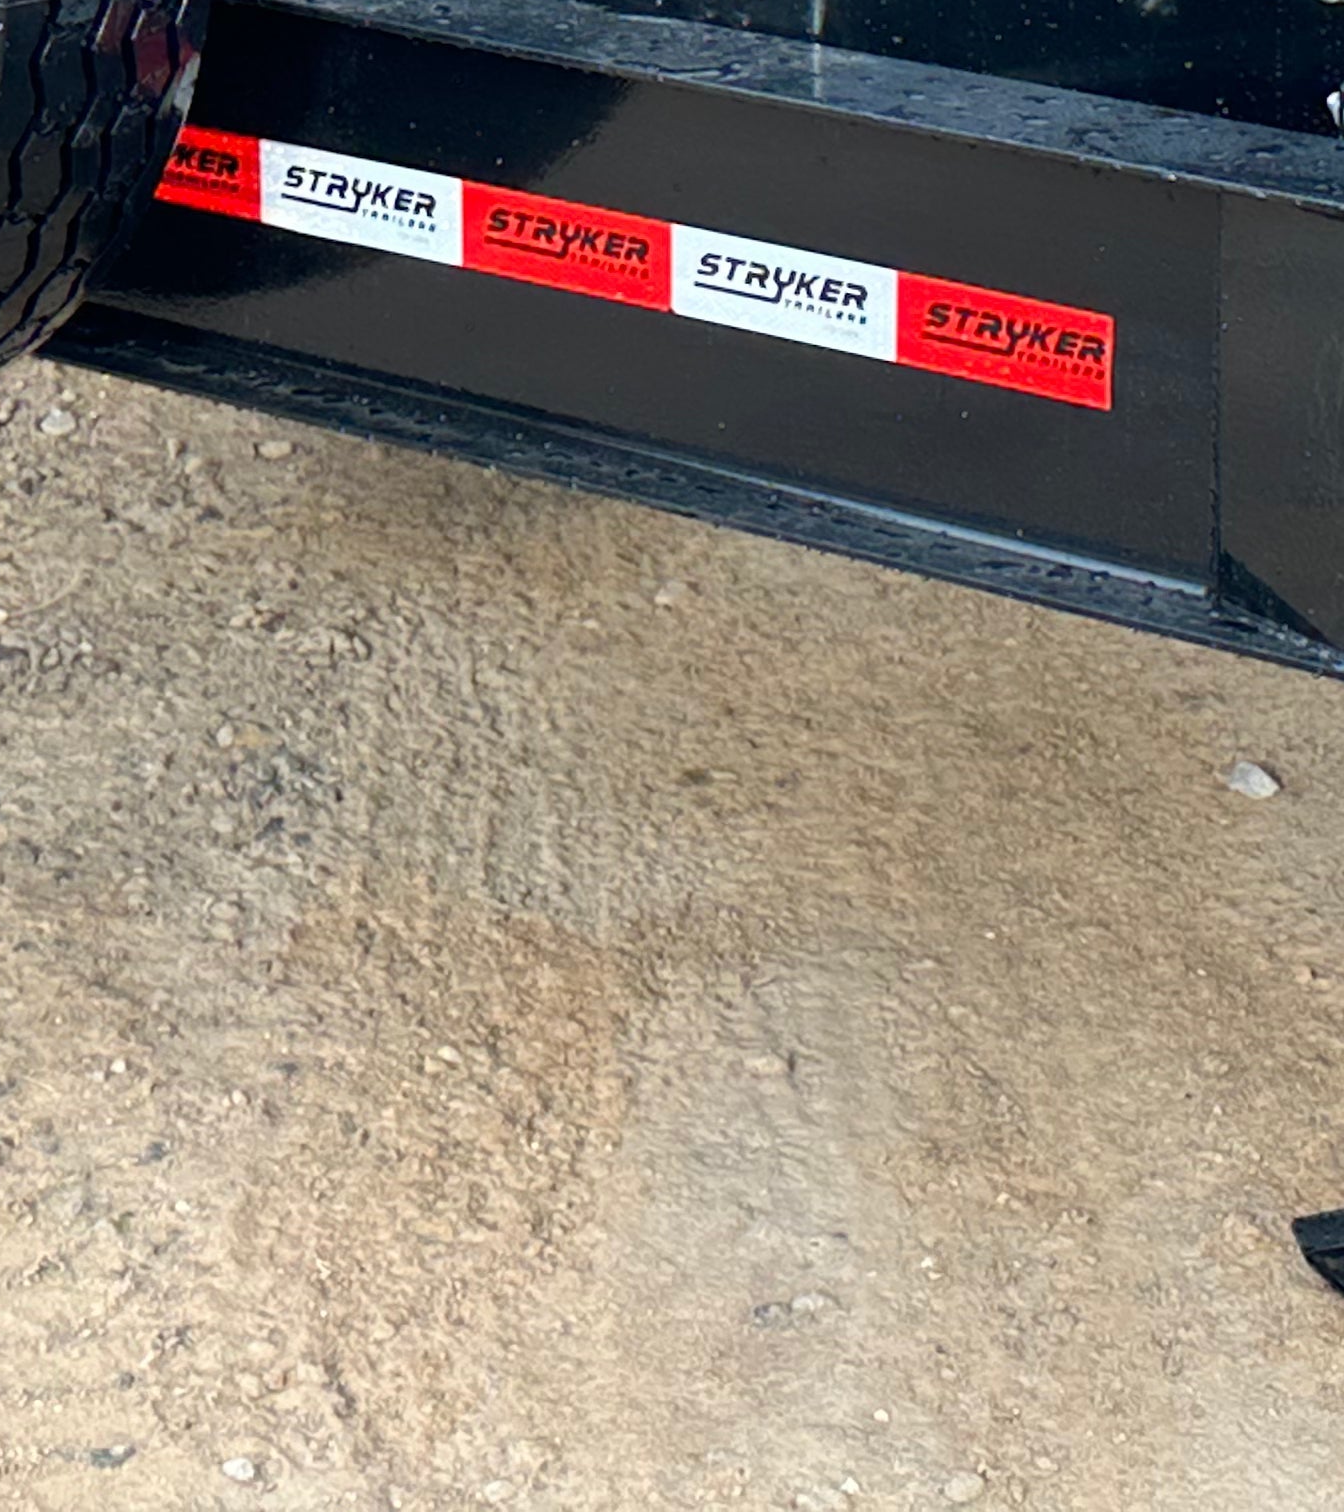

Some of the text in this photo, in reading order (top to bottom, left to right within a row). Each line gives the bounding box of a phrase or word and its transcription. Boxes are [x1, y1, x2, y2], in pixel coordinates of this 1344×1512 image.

[281, 165, 437, 218] STRYKER
[484, 207, 649, 264] STRYKER
[694, 253, 868, 310] STRYKER
[922, 302, 1106, 364] STRYKER
